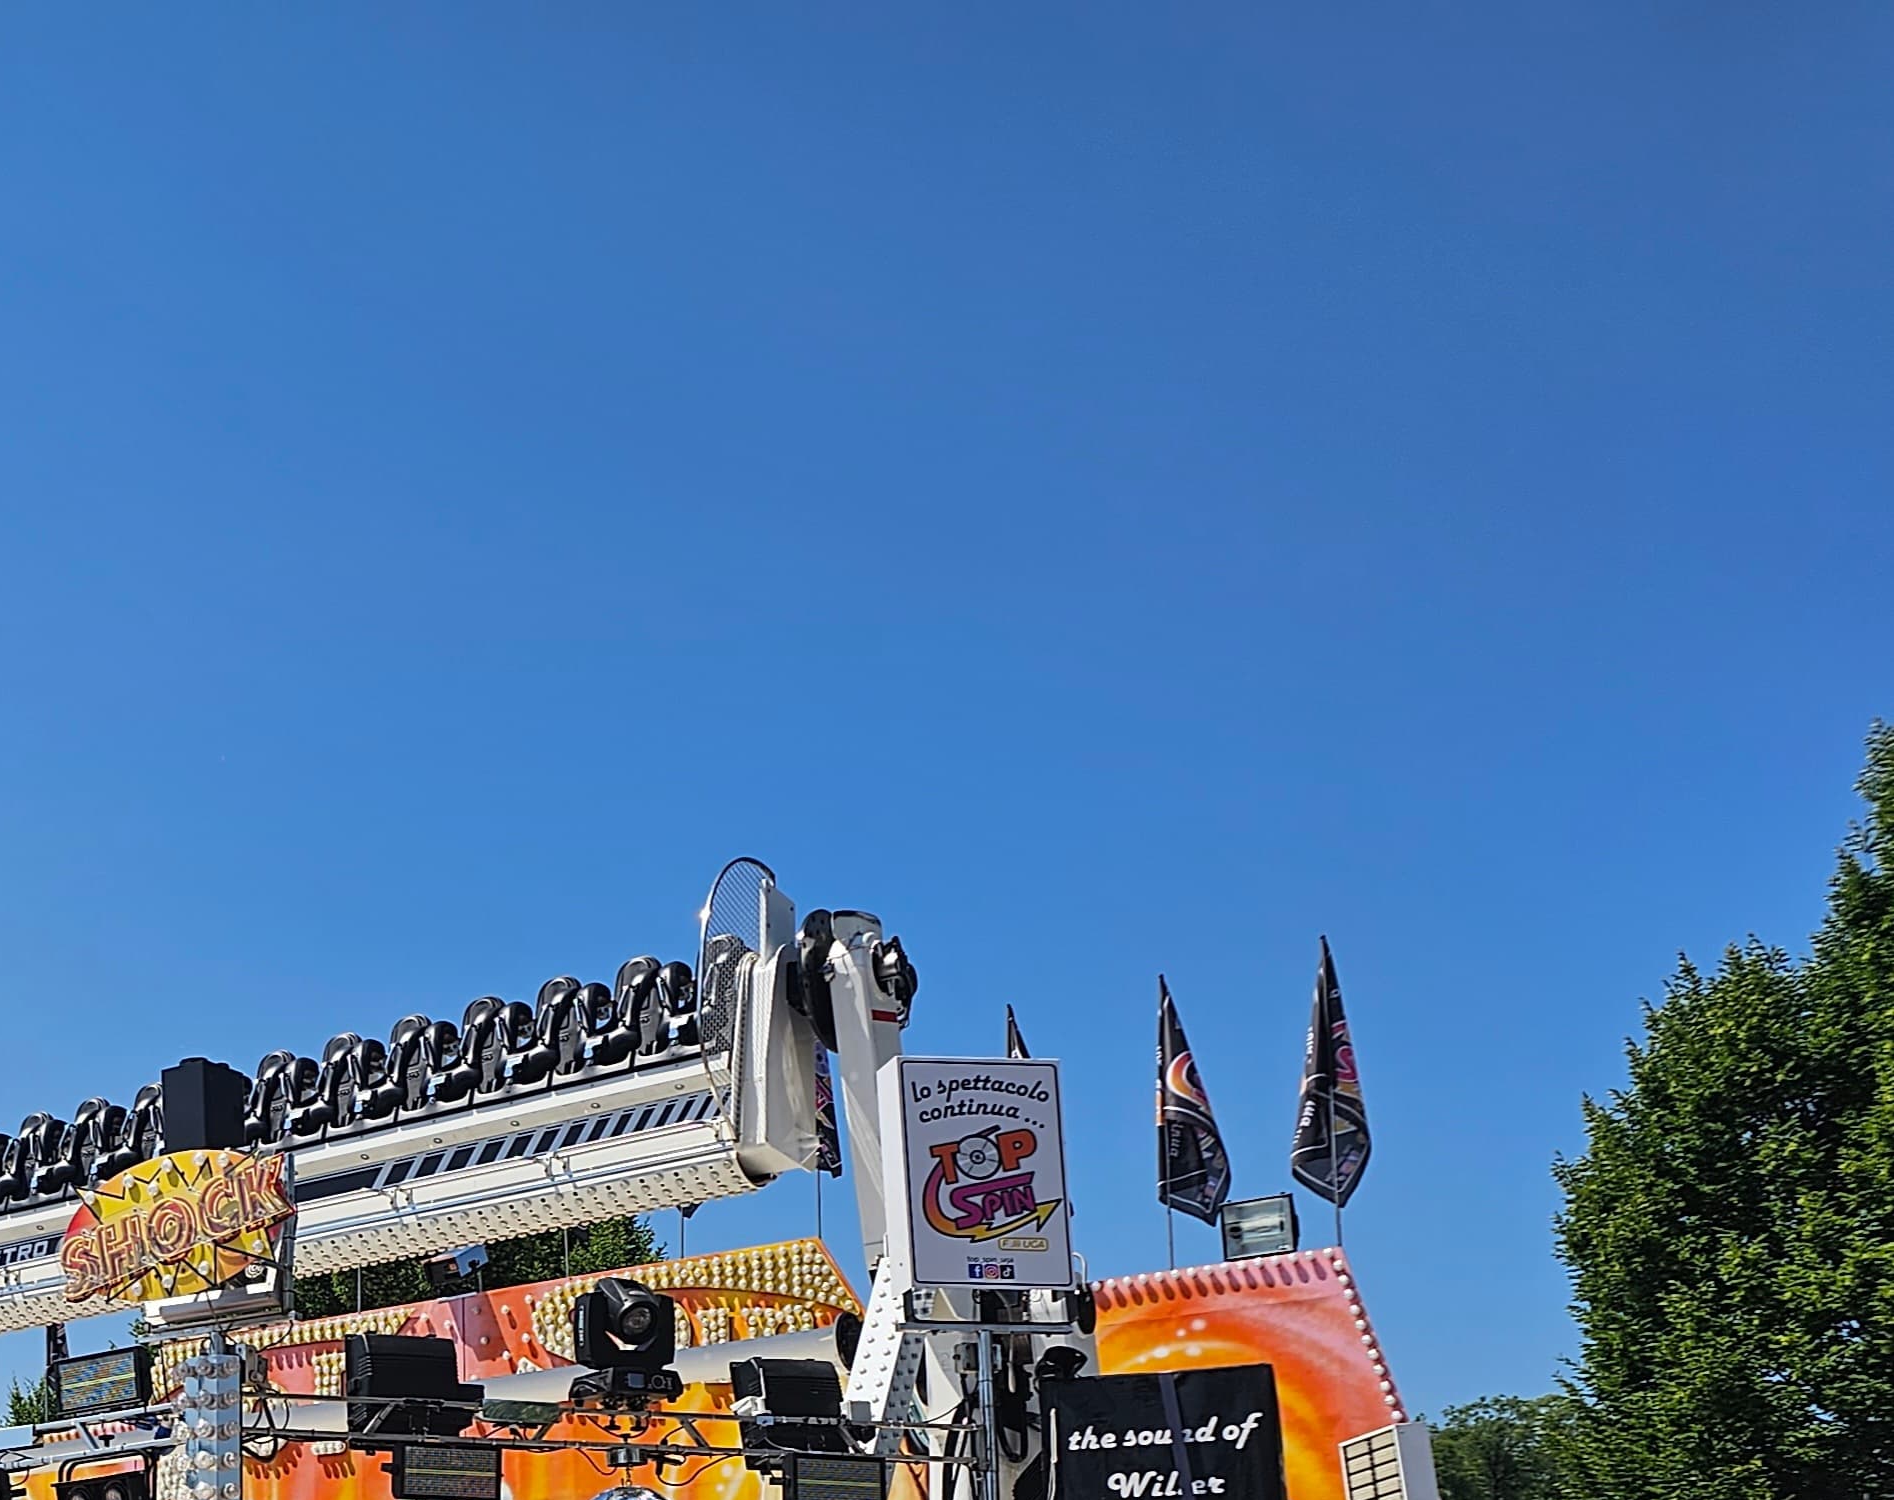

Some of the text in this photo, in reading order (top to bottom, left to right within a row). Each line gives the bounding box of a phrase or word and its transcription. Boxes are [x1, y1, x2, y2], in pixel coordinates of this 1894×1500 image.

[911, 1075, 1050, 1103] lo spettacolo
[929, 1126, 1038, 1185] TOP
[950, 1171, 1038, 1230] SPIN
[61, 1152, 296, 1304] SHOCK
[1068, 1425, 1118, 1451] the
[1221, 1412, 1264, 1450] of
[1106, 1470, 1227, 1498] Wiler
